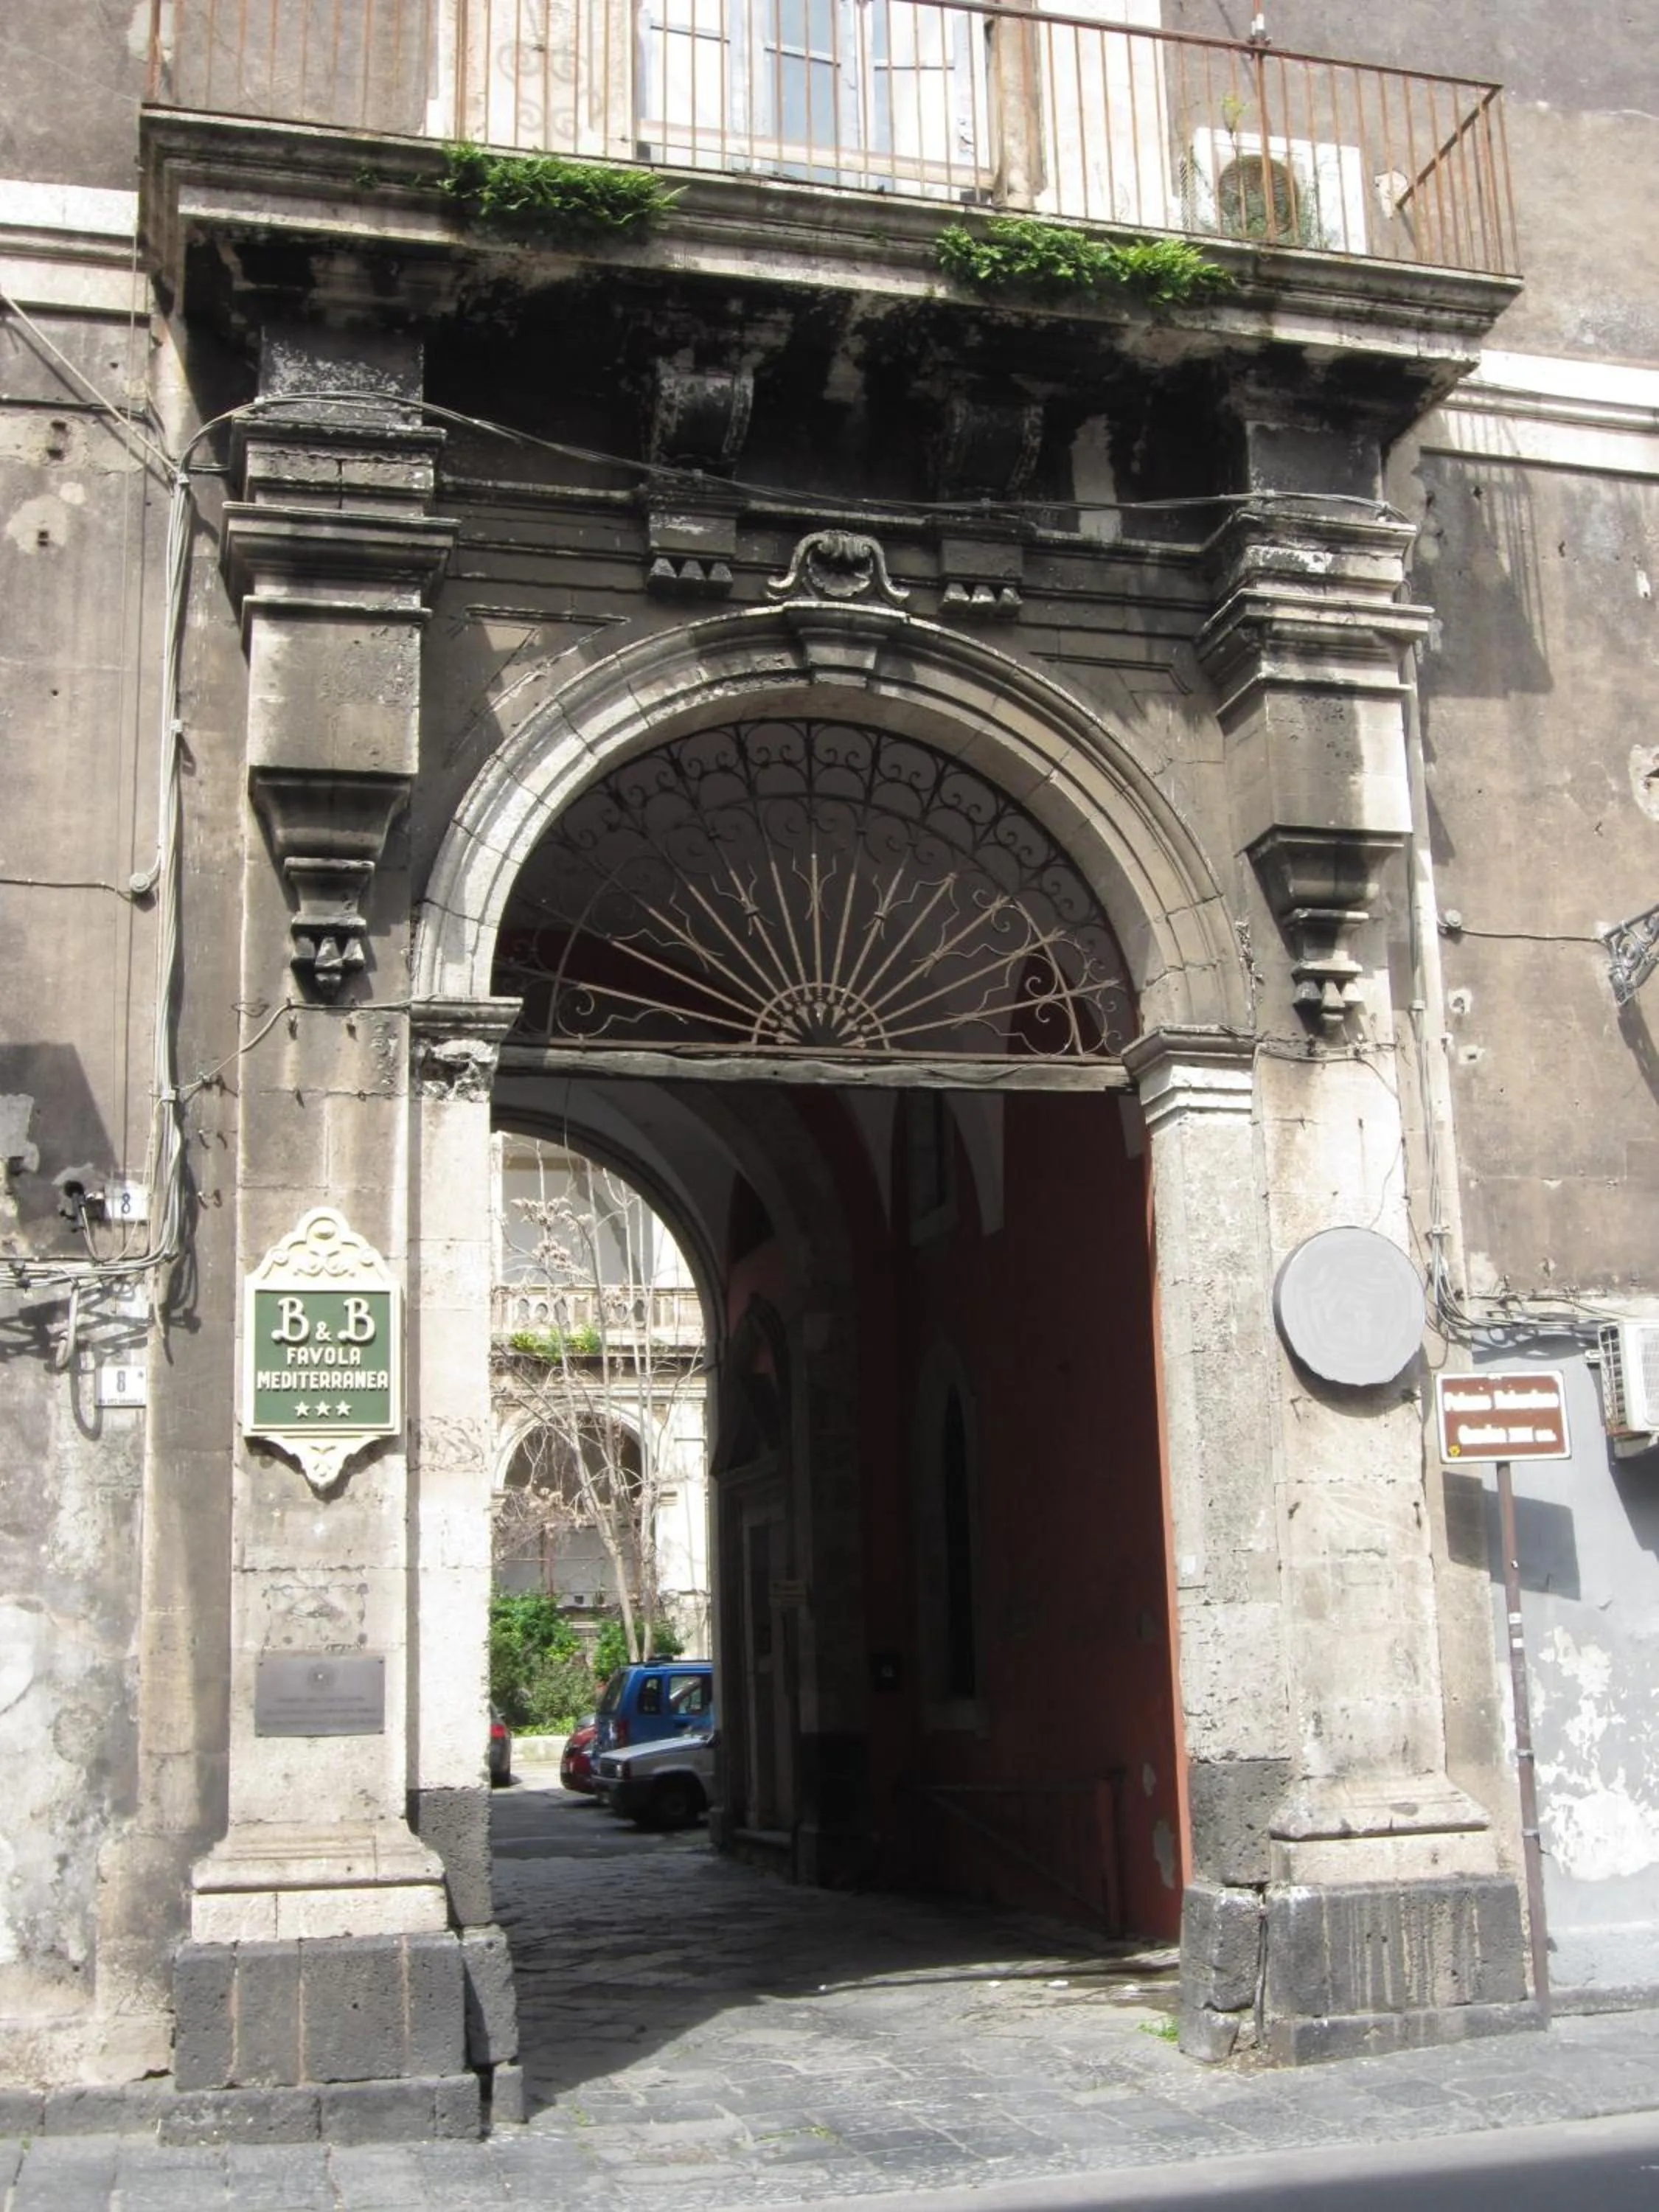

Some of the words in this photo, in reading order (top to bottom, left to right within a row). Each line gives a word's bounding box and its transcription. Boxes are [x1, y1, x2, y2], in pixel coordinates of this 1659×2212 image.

[121, 1192, 131, 1214] 8
[271, 1297, 310, 1342] B
[315, 1321, 332, 1341] &
[337, 1298, 375, 1342] B
[286, 1346, 361, 1366] FAVOLA
[257, 1369, 389, 1389] MEDITERRANEA
